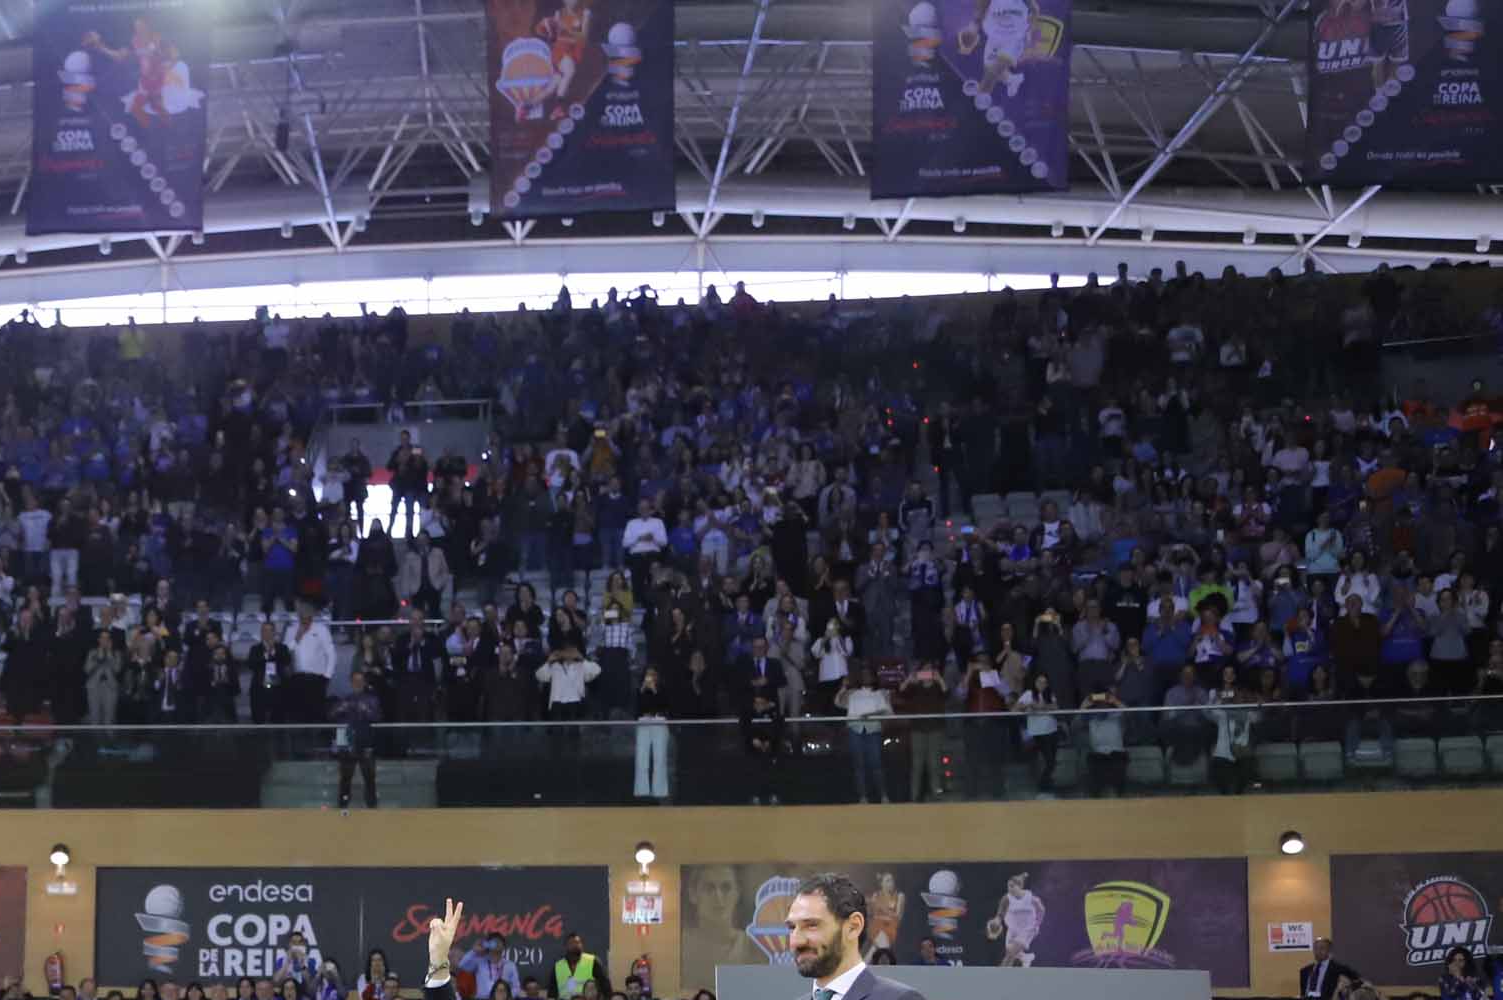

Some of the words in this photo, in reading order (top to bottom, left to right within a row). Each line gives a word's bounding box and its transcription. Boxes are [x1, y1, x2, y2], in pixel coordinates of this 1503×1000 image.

[208, 880, 313, 902] endesa
[207, 913, 317, 946] COPA
[1410, 919, 1488, 949] UNI
[199, 948, 218, 962] DE
[501, 948, 543, 965] 020
[1409, 943, 1485, 962] GIRA
[199, 963, 219, 976] LA
